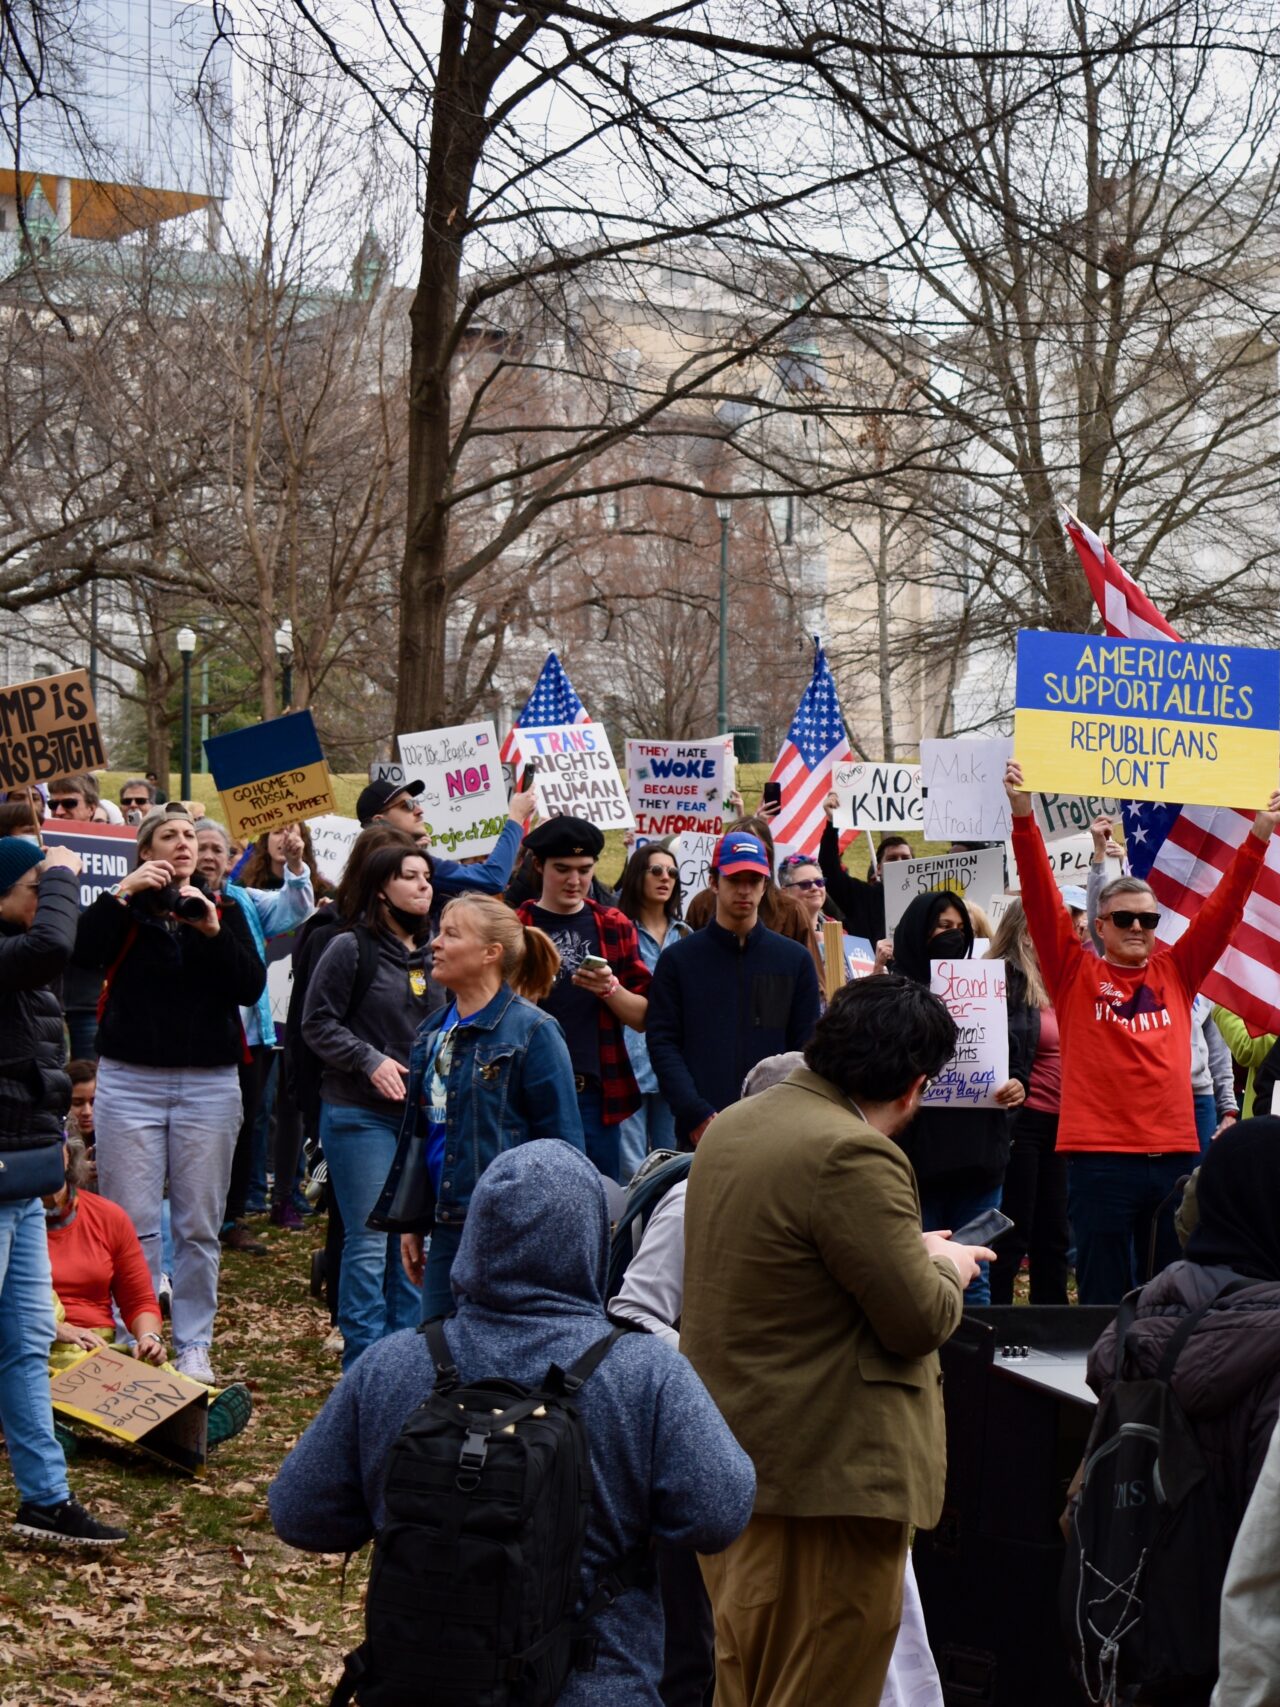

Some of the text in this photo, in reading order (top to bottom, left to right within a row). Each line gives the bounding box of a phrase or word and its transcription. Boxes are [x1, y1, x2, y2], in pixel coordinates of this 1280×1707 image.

[1076, 645, 1231, 683] AMERICANS
[1043, 672, 1253, 720] SUPPORT ALLIES
[0, 685, 46, 738] MP
[524, 730, 596, 754] TRANS
[638, 745, 707, 758] THEY HATE
[1071, 721, 1218, 761] REPUBLICANS
[531, 751, 610, 774] RIGHTS
[931, 752, 987, 785] Make
[1101, 757, 1170, 789] DON'T
[233, 772, 306, 802] GO HOME TO
[445, 764, 491, 798] NO!
[561, 770, 589, 782] are
[871, 768, 912, 794] NO
[249, 789, 299, 809] RUSSIA,
[541, 780, 620, 804] HUMAN
[644, 784, 699, 795] BECAUSE
[287, 793, 330, 813] PUPPET
[547, 799, 626, 822] RIGHTS
[638, 798, 707, 812] THEY FEAR
[634, 813, 723, 835] INFORMED
[925, 800, 983, 835] Afraid
[77, 852, 128, 877] FEND
[907, 855, 978, 875] DEFINITION
[937, 962, 988, 1000] Stand
